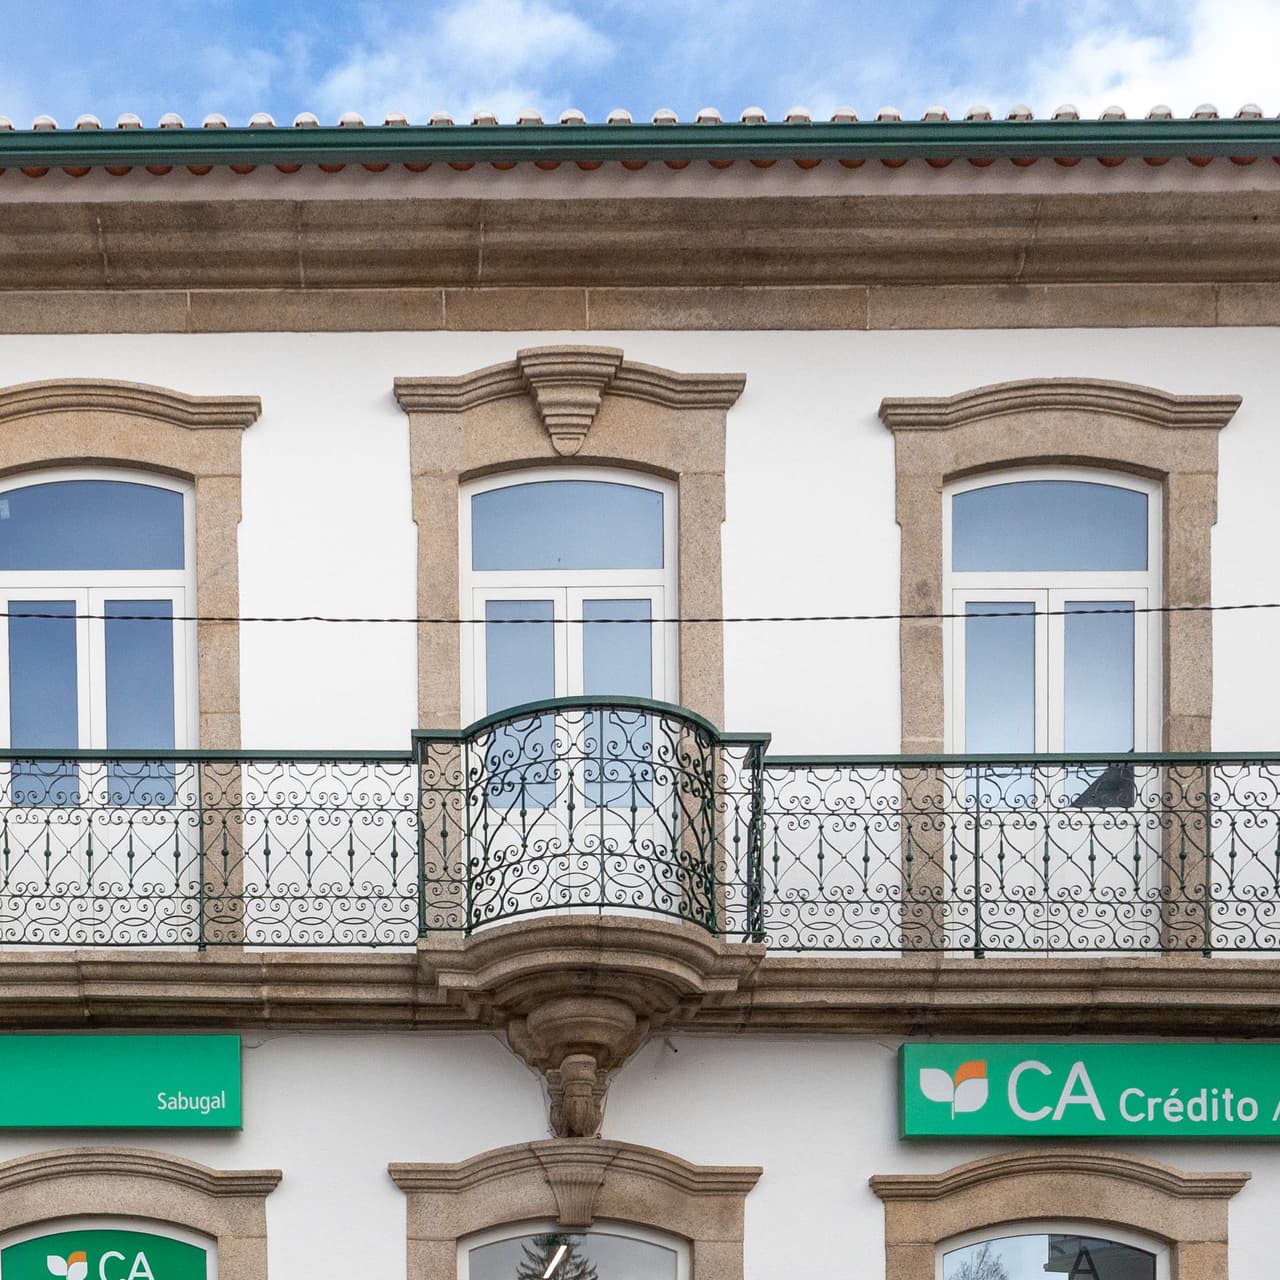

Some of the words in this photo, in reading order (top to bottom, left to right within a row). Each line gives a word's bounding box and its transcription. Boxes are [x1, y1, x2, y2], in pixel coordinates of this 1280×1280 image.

[157, 1090, 225, 1114] Sabugal
[1007, 1060, 1106, 1121] CA
[1119, 1088, 1259, 1122] Crédito
